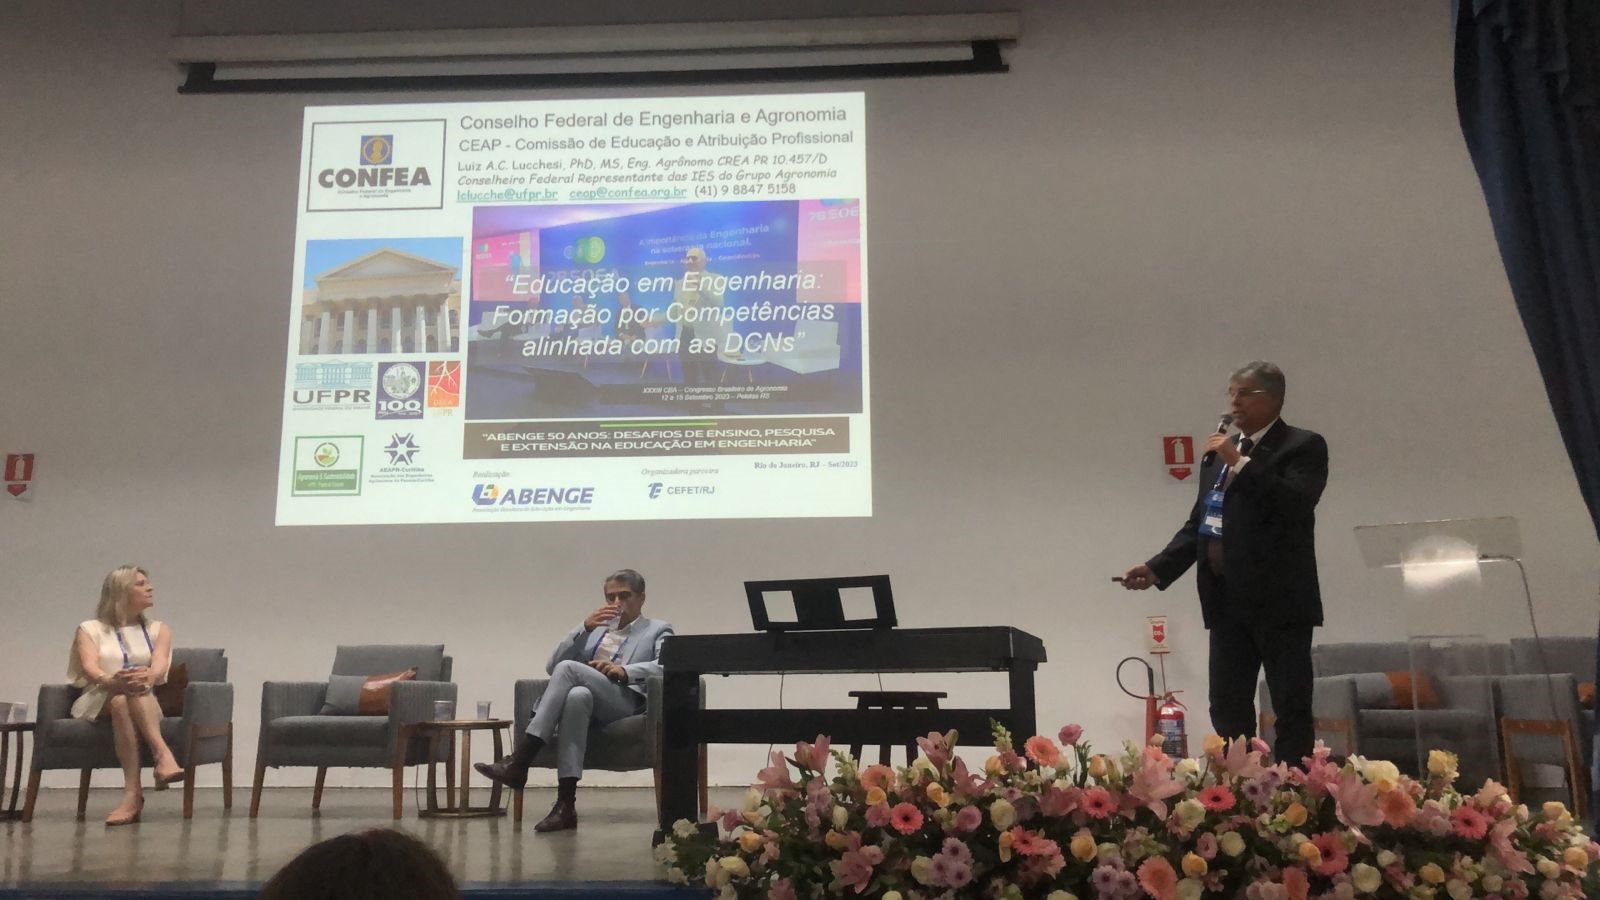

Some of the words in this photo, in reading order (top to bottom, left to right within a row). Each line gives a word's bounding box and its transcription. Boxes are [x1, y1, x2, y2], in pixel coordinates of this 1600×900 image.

[460, 113, 539, 130] Conselho
[544, 111, 607, 128] Federal
[613, 111, 633, 127] de
[639, 109, 735, 129] Engenharia
[741, 112, 751, 125] e
[755, 106, 847, 126] Agronomia
[459, 139, 502, 151] CEAP
[515, 137, 584, 151] Comissão
[589, 136, 606, 149] de
[611, 134, 681, 151] Educação
[685, 137, 694, 147] e
[697, 132, 767, 149] Atribuição
[772, 131, 854, 145] Profissional
[458, 160, 482, 172] Luiz
[486, 160, 509, 172] A.C.
[512, 158, 566, 172] Lucchesi,
[570, 158, 595, 171] PhD,
[600, 158, 622, 171] MS,
[627, 157, 651, 171] Eng.
[656, 154, 714, 170] Agrônomo
[717, 154, 750, 167] CREA
[753, 154, 769, 166] PR
[772, 152, 828, 166] 10.457/D
[318, 167, 432, 188] CONFEA
[458, 174, 526, 186] Conselheiro
[530, 173, 575, 185] Federal
[578, 171, 664, 185] Representante
[667, 171, 688, 182] das
[691, 171, 715, 182] IES
[718, 170, 733, 181] do
[736, 169, 771, 183] Grupo
[775, 168, 837, 183] Agronomia
[569, 187, 687, 200] ceap@confea.org.br
[694, 185, 718, 198] (41)
[721, 185, 728, 196] 9
[732, 184, 764, 195] 8847
[768, 183, 796, 194] 5158
[637, 278, 674, 293] em
[682, 270, 824, 296] Engenharia:
[493, 302, 612, 329] Formação
[618, 308, 659, 329] por
[666, 299, 835, 326] Competências
[522, 334, 623, 357] alinhada
[631, 339, 680, 356] com
[688, 339, 716, 354] as
[292, 390, 371, 404] UFPR
[755, 385, 788, 393] Agronomia
[548, 432, 565, 440] 50
[567, 432, 611, 440] ANOS:
[614, 430, 682, 439] DESAFIOS
[685, 430, 703, 438] DE
[706, 429, 762, 439] ENSINO,
[765, 428, 835, 437] PESQUISA
[501, 443, 509, 451] E
[512, 441, 588, 451] EXTENSÃO
[591, 442, 612, 450] NA
[614, 440, 691, 451] EDUCAÇÃO
[695, 440, 716, 449] EM
[754, 461, 767, 469] Rio
[809, 461, 820, 469] RJ
[499, 487, 595, 505] ABENGE
[667, 486, 715, 495] CEFET/RJ
